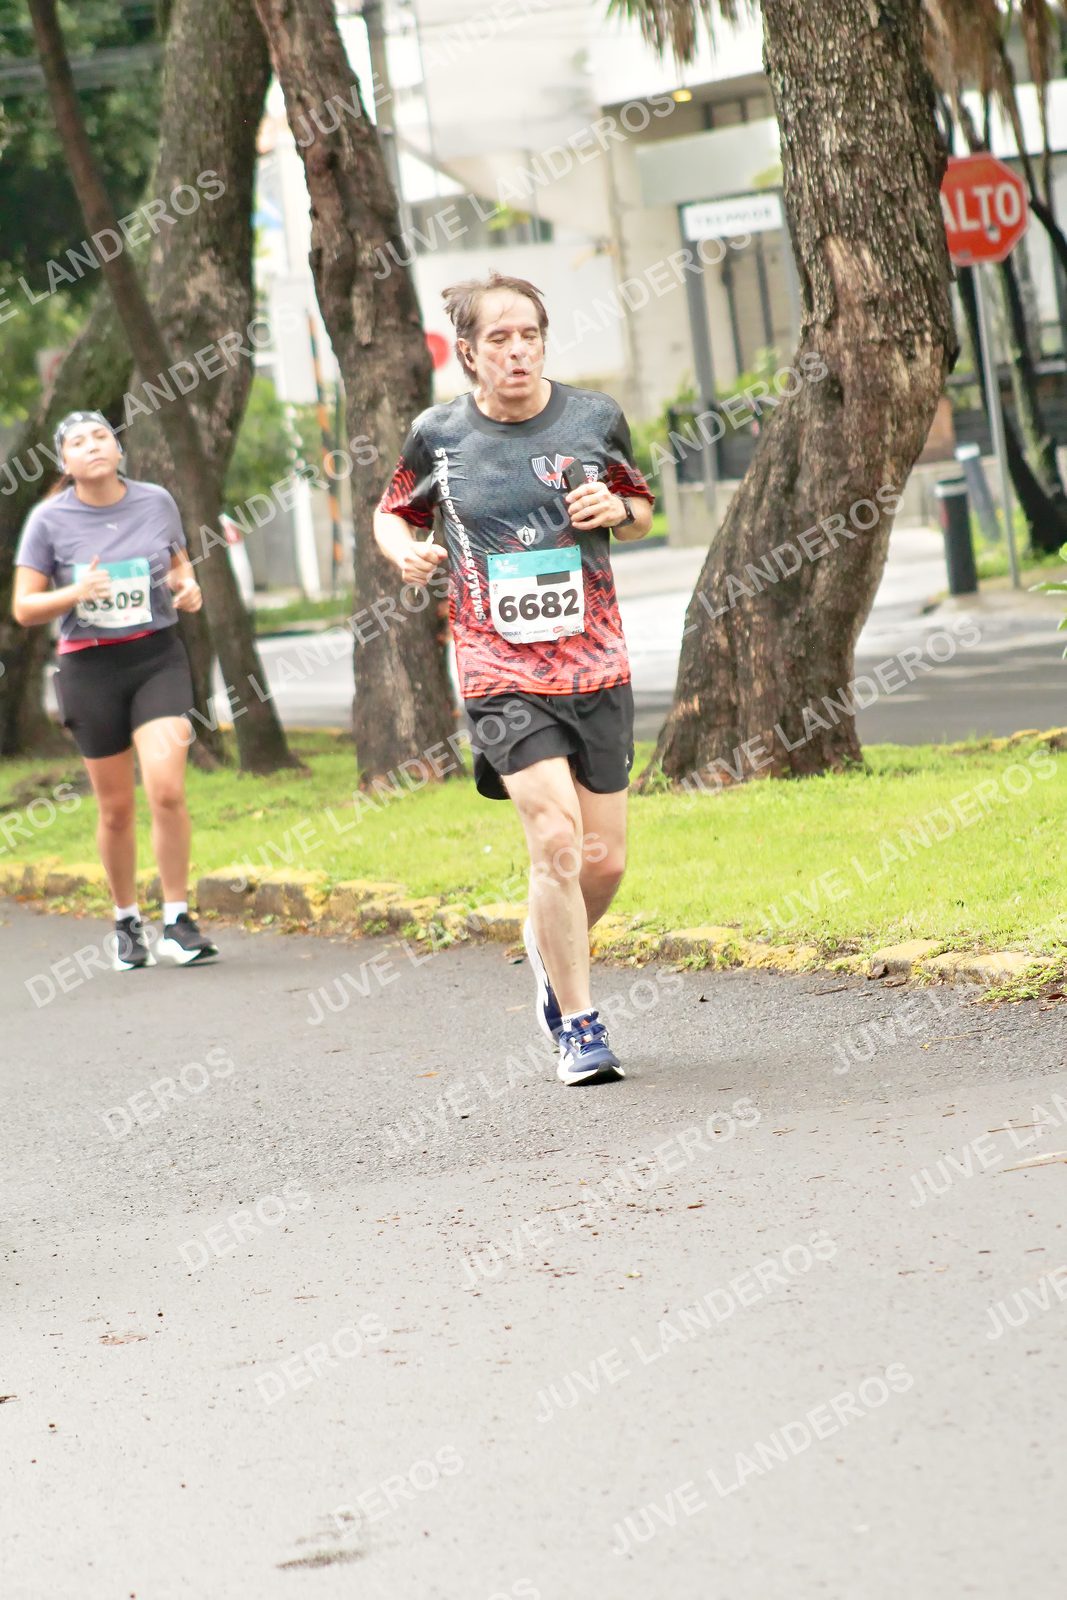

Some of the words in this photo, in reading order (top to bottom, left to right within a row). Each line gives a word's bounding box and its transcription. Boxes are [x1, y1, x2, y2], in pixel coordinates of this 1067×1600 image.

[434, 447, 450, 497] GOALS
[466, 570, 487, 620] SMALL
[498, 588, 580, 623] 6682
